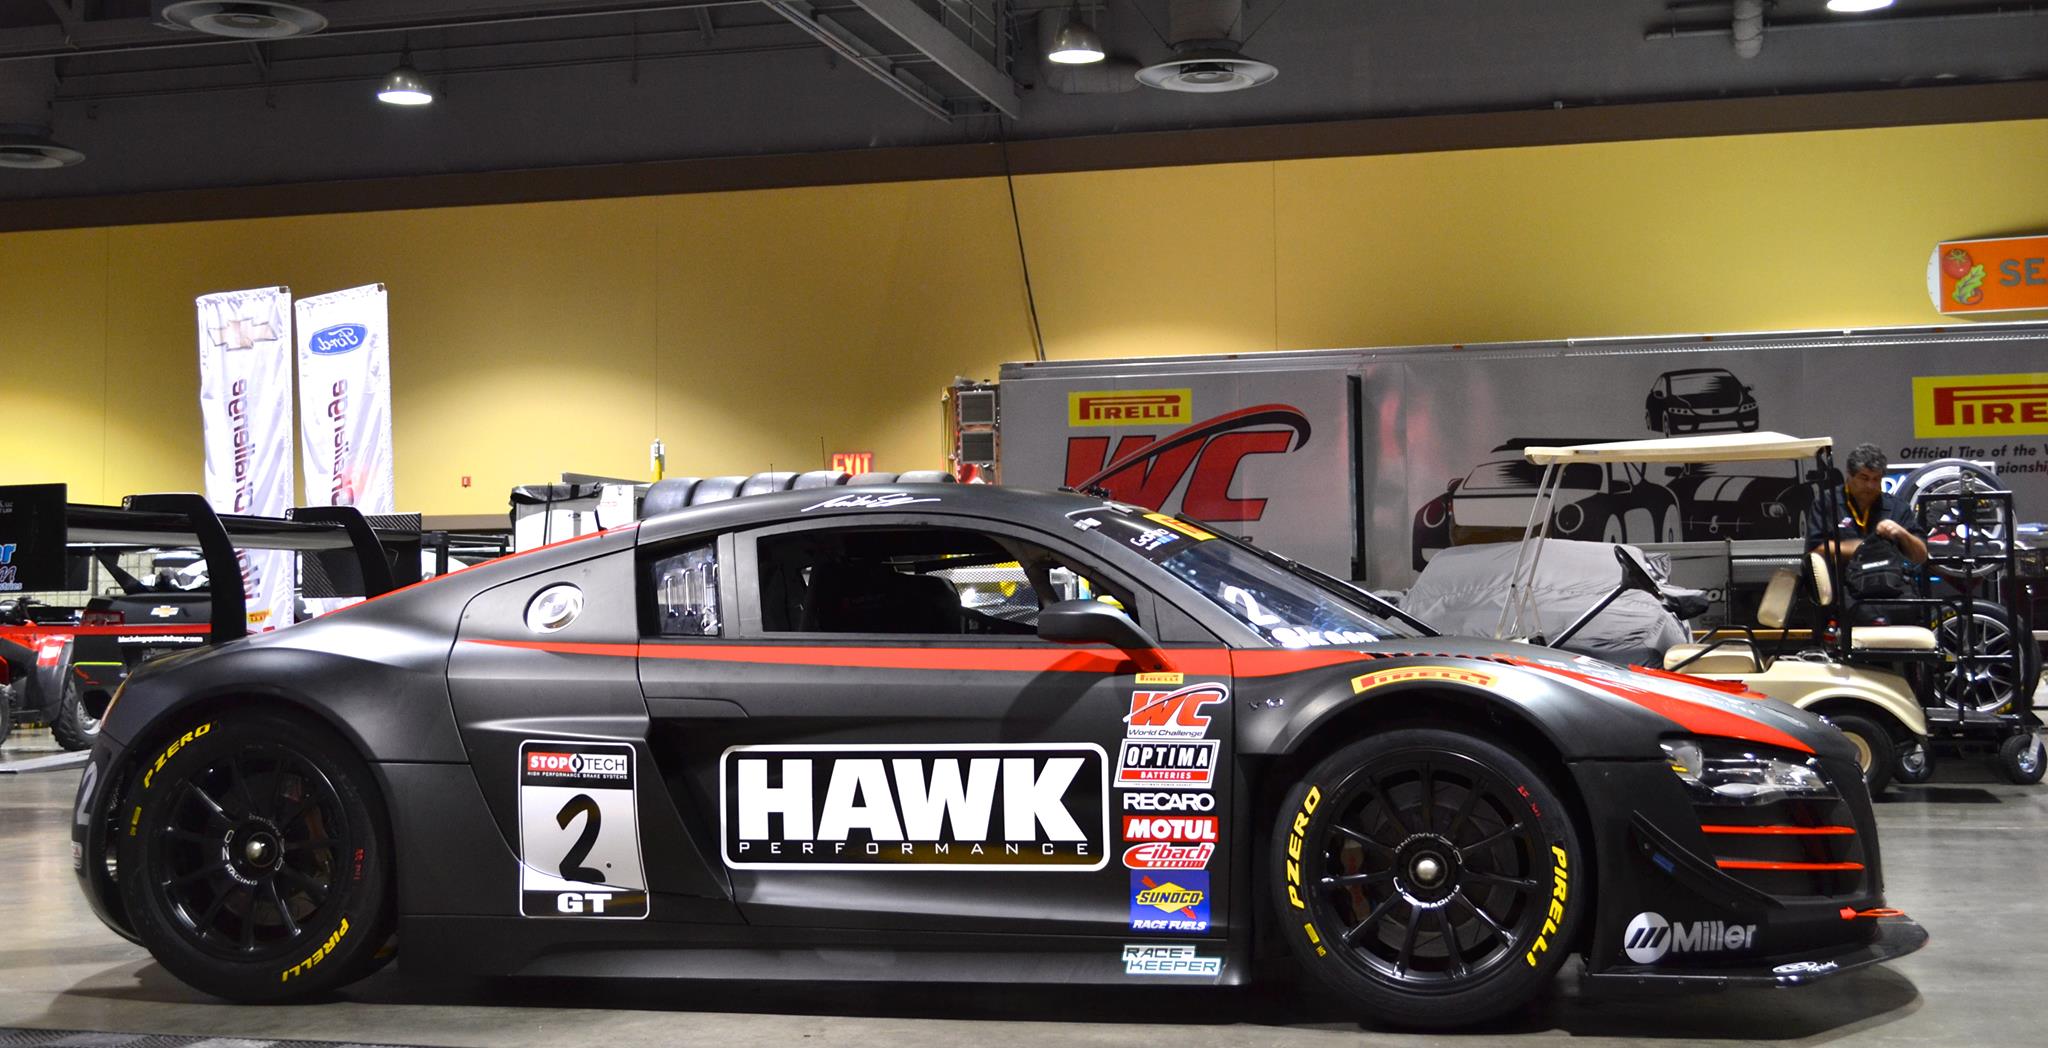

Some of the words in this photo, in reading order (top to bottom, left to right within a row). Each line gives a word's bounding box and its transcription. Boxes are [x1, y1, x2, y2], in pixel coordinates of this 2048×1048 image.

[1079, 395, 1182, 420] PIRELLI
[1900, 446, 1953, 459] Official
[1958, 446, 1985, 458] Tire
[1991, 445, 2008, 457] of
[2014, 444, 2036, 457] the
[832, 453, 872, 475] EXIT
[1065, 429, 1295, 522] WC
[1223, 584, 1282, 626] 2
[1129, 692, 1221, 727] WC
[1158, 729, 1203, 737] Challenge
[1126, 746, 1209, 767] OPTIMA
[1140, 771, 1192, 779] BATTERIES
[738, 758, 1088, 841] HAWK
[1123, 792, 1215, 811] RECARO
[556, 793, 606, 882] 2
[1126, 818, 1216, 839] MOTUL
[739, 842, 1089, 855] PERFORMANCE
[1123, 843, 1212, 869] Eibach
[557, 893, 612, 913] GT
[1139, 890, 1202, 904] SUNOCO
[1526, 845, 1568, 968] PIRELLI
[1132, 920, 1166, 929] RACE
[1168, 920, 1207, 931] FUELS
[1672, 920, 1758, 953] Miller
[281, 917, 350, 983] PIRELLI
[1129, 961, 1217, 972] KEEPER
